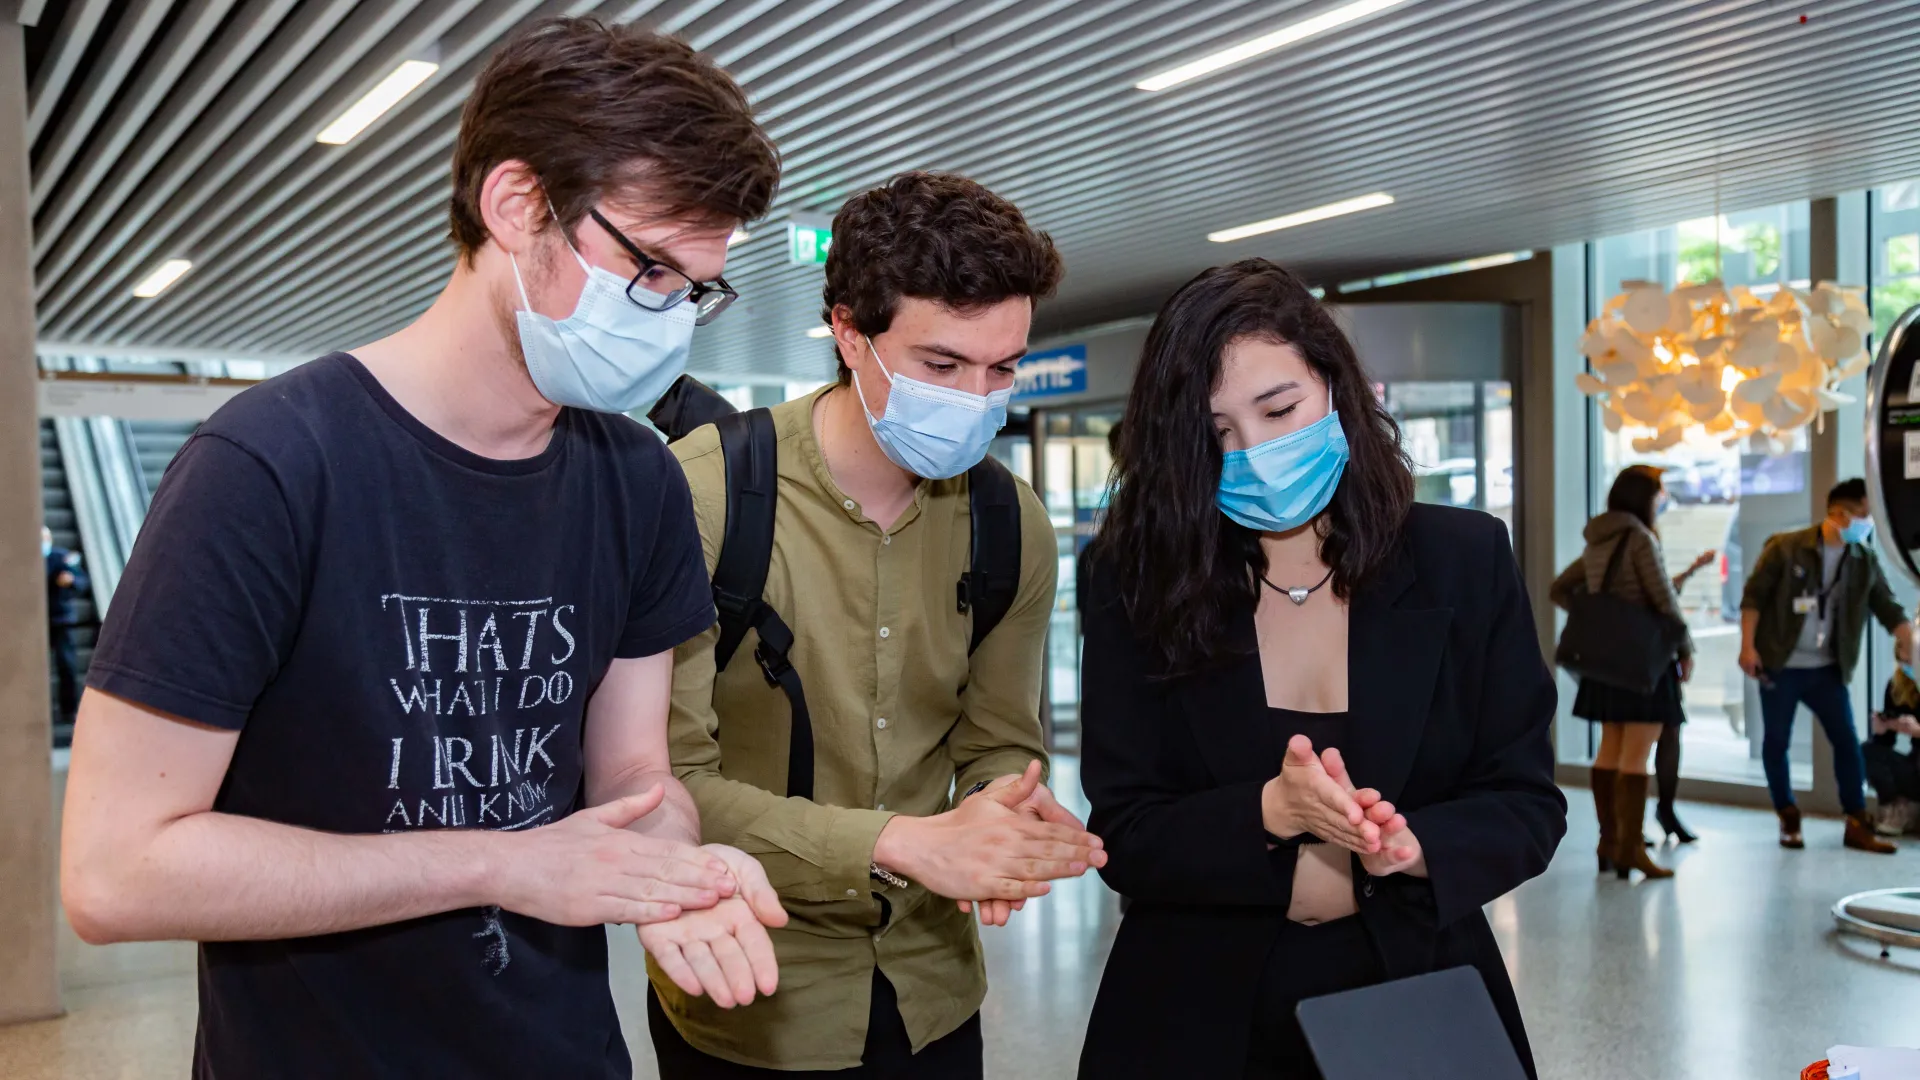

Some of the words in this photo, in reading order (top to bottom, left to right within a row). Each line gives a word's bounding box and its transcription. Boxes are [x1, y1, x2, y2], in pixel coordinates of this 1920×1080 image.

[381, 593, 576, 673] THATS
[517, 670, 574, 710] DO
[387, 737, 404, 790] I
[478, 772, 555, 823] KNOW
